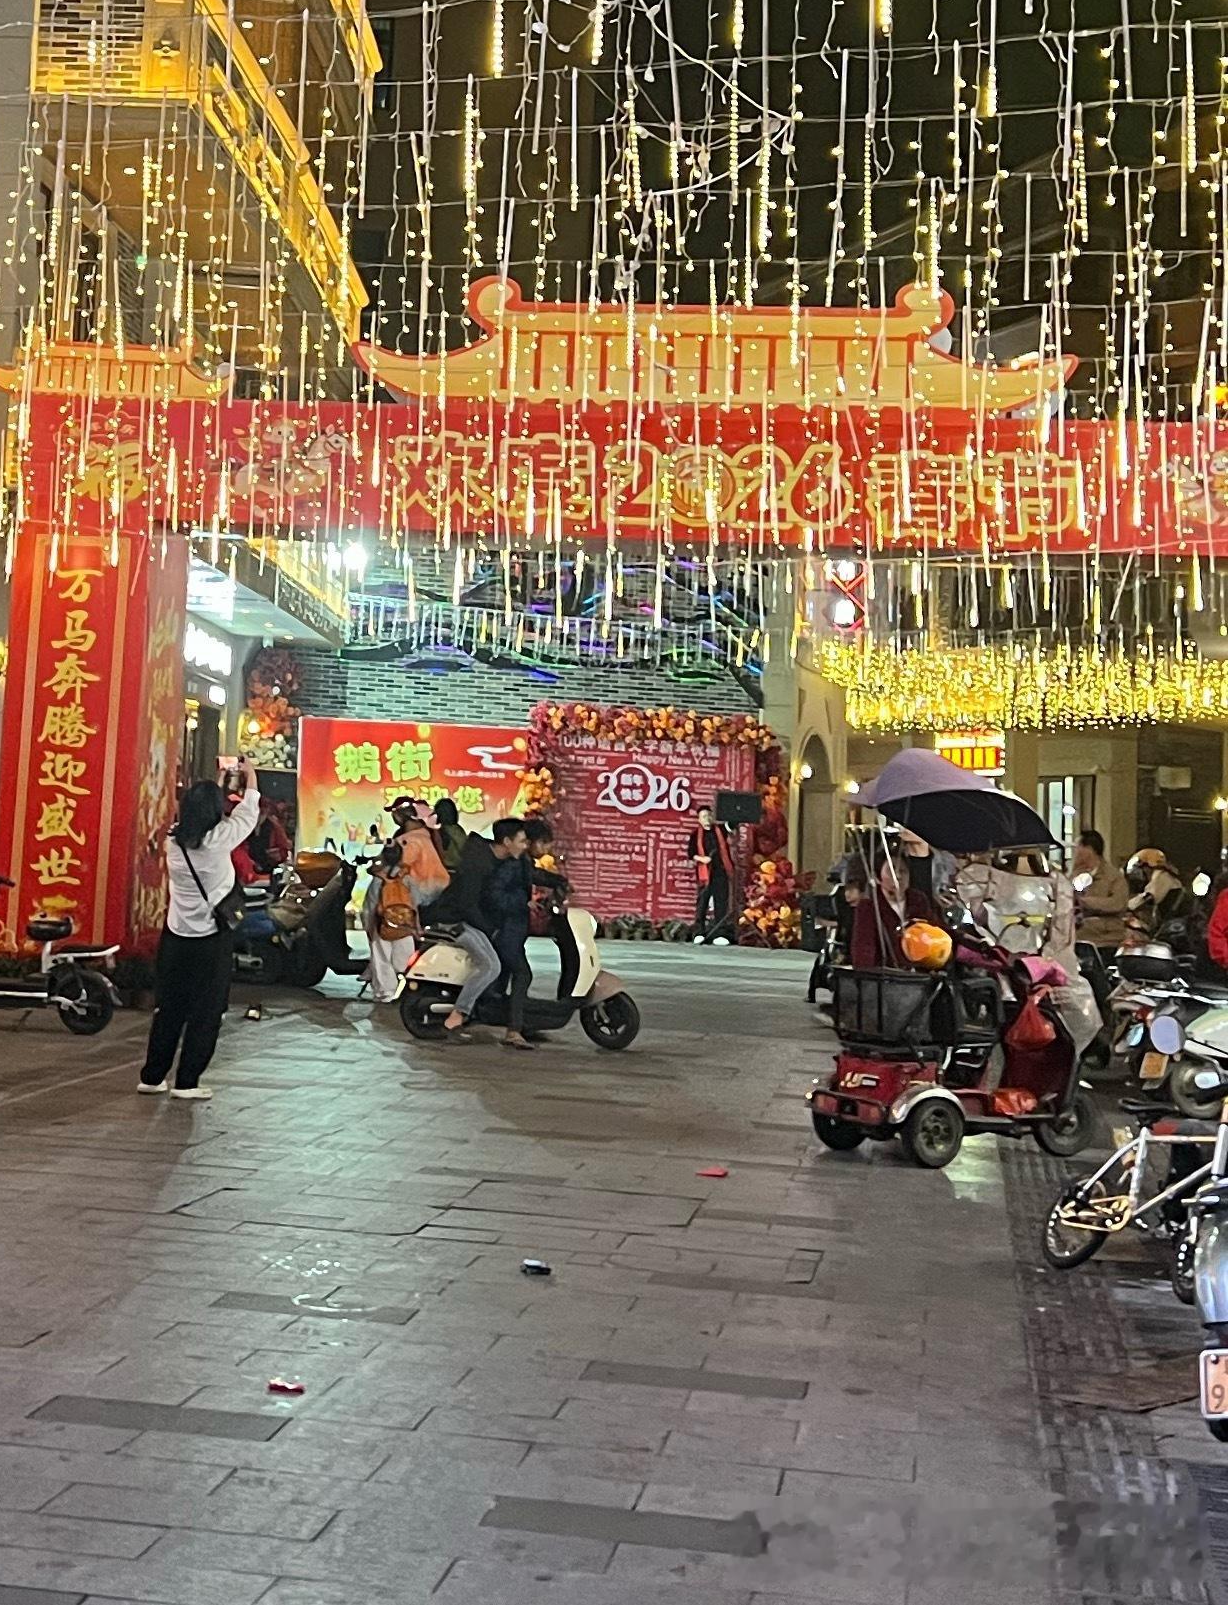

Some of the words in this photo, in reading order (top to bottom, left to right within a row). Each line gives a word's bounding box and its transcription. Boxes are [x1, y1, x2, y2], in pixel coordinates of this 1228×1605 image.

[29, 567, 104, 887] 万马奔腾迎盛世
[333, 740, 433, 784] 鹅街
[632, 753, 666, 767] Happy
[668, 755, 692, 766] New
[693, 756, 719, 767] Year
[596, 763, 691, 815] 2026
